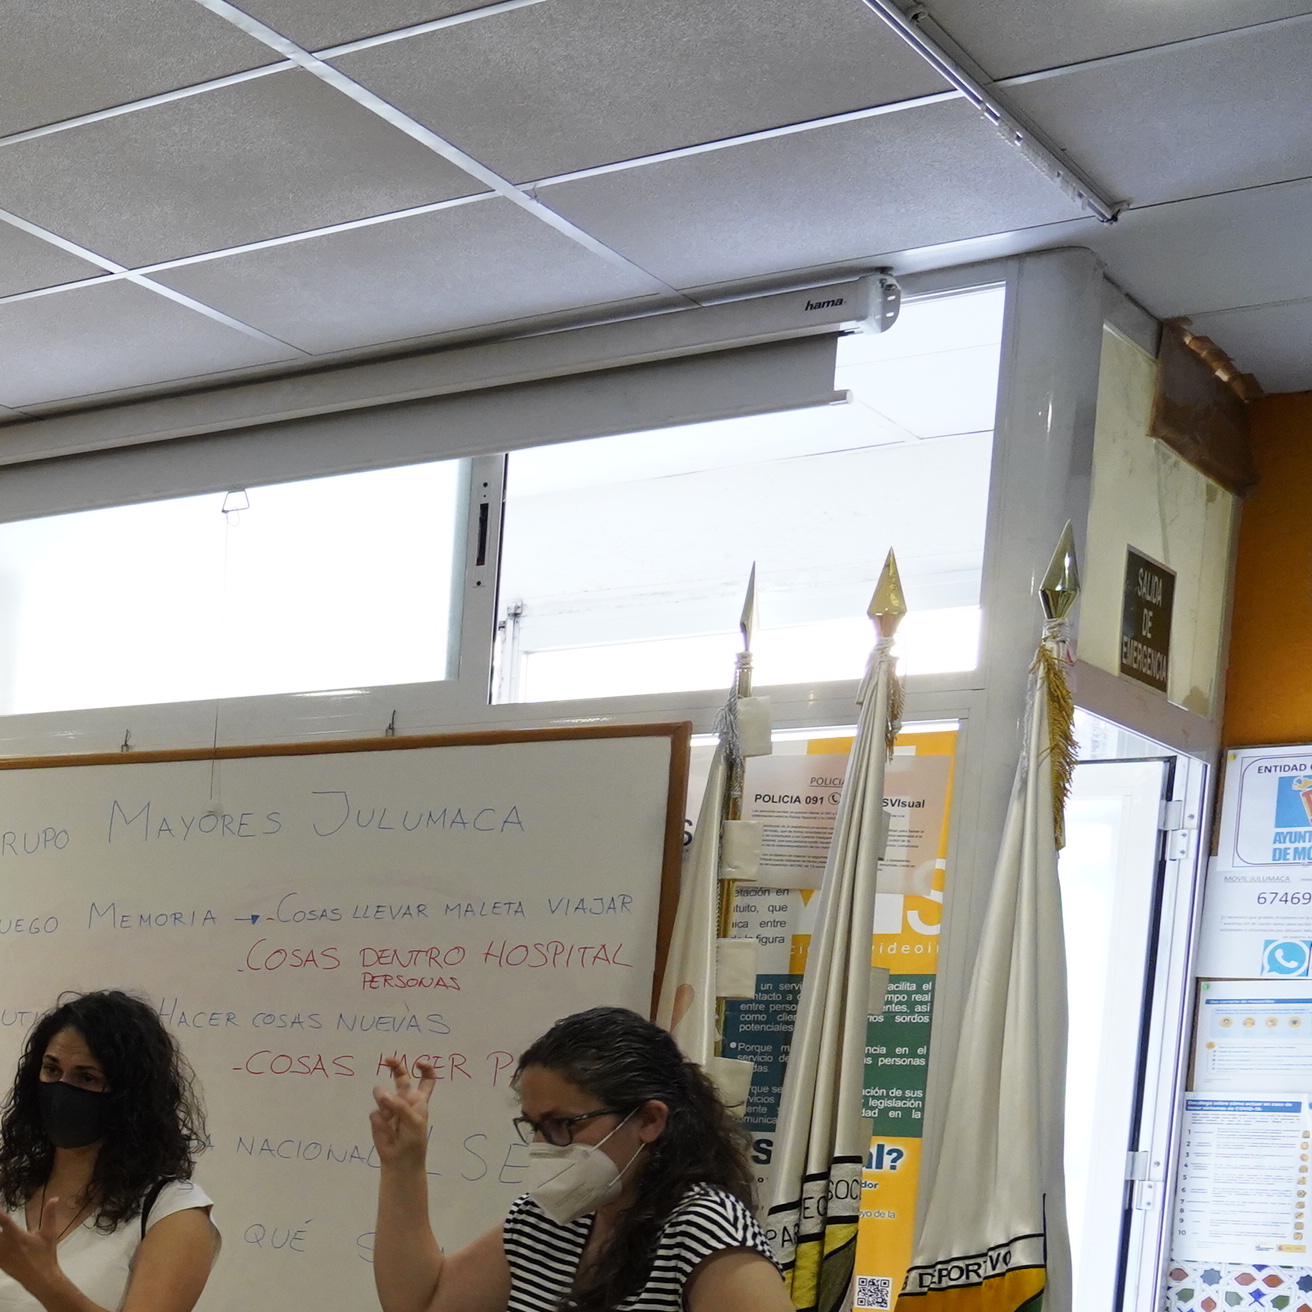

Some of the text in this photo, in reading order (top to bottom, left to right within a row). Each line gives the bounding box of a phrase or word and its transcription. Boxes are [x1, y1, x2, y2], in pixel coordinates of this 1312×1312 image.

[805, 298, 844, 311] hama
[1138, 566, 1163, 608] SALIDA
[1141, 608, 1154, 639] DE
[1121, 636, 1167, 682] EMERGENCIA
[1257, 763, 1307, 774] ENTIDAD
[754, 794, 824, 805] POLICIA 091
[108, 799, 282, 843] MAYORES
[312, 790, 525, 837] JULUMACA
[1272, 847, 1290, 862] DE
[776, 888, 789, 896] en
[89, 902, 217, 930] MEMORIA
[353, 903, 428, 922] LLEVAR
[445, 900, 527, 919] MALETA
[548, 894, 634, 916] VIAJAR
[767, 904, 788, 914] que
[759, 919, 787, 928] entre
[359, 946, 466, 969] DENTRO
[483, 940, 634, 969] HOSPITAL
[887, 981, 917, 991] acilita
[923, 981, 932, 991] el
[885, 993, 908, 1003] mpo
[912, 992, 931, 1001] real
[740, 1003, 765, 1011] entre
[770, 1003, 796, 1013] perso
[252, 1012, 323, 1031] COSAS
[895, 1013, 930, 1023] sordos
[738, 1042, 772, 1055] Porque
[865, 1044, 886, 1054] ncia
[917, 1045, 927, 1055] el
[737, 1053, 774, 1062] servicio
[878, 1056, 926, 1066] personas
[889, 1087, 902, 1097] de
[905, 1089, 923, 1097] sus
[869, 1097, 922, 1109] legislación
[747, 1105, 767, 1113] ente
[888, 1110, 902, 1118] en
[911, 1109, 921, 1119] la
[861, 1181, 879, 1189] dor
